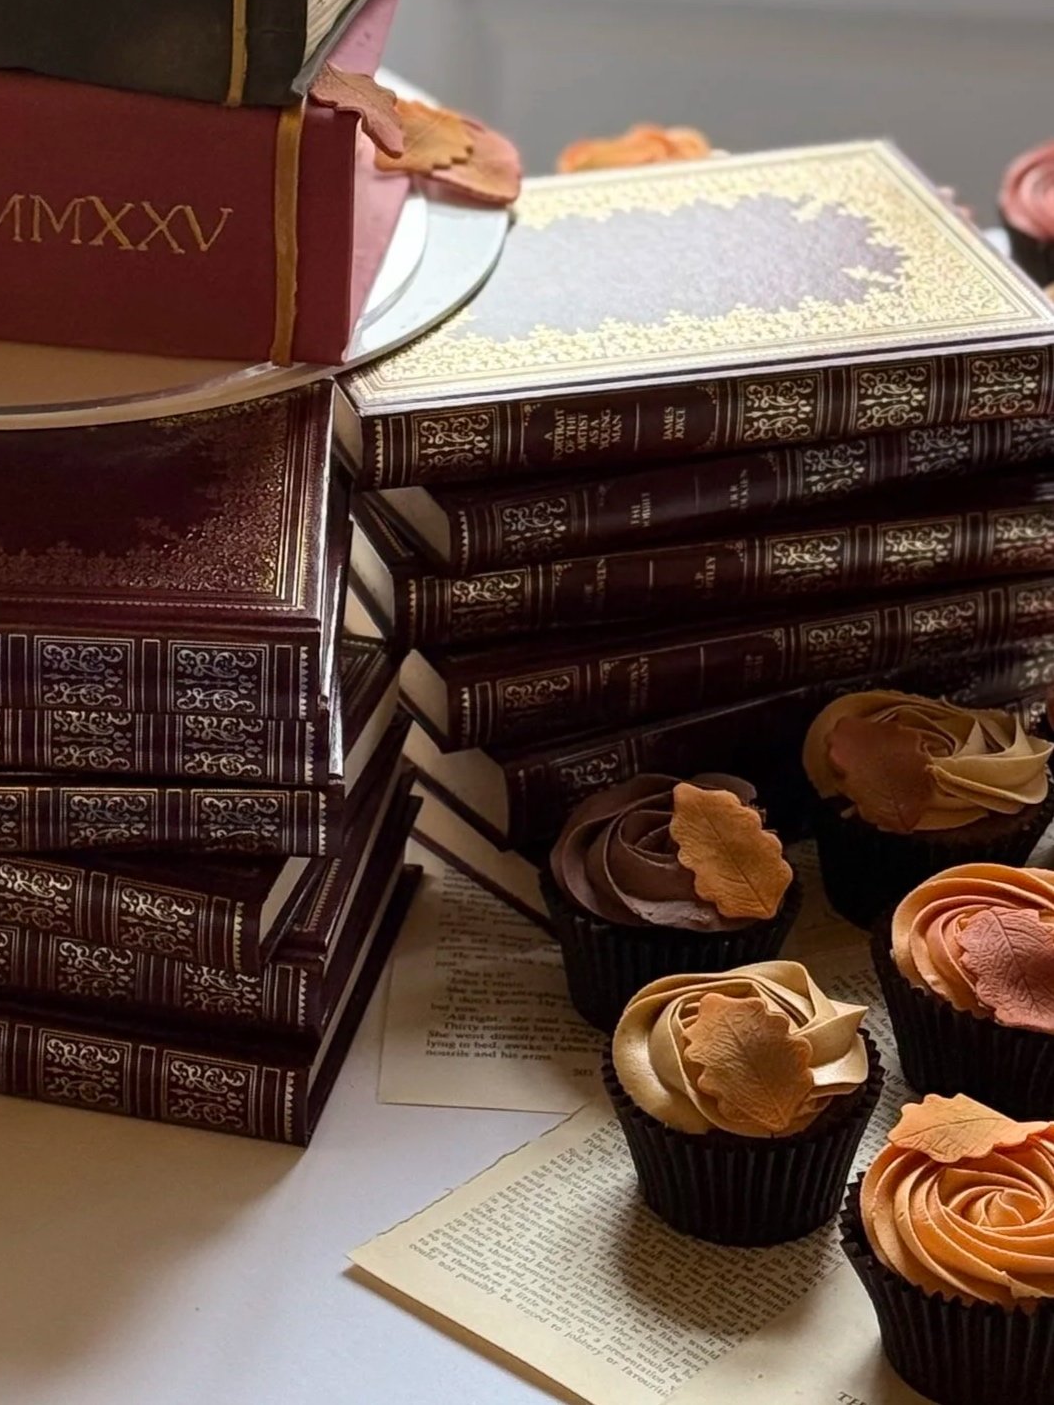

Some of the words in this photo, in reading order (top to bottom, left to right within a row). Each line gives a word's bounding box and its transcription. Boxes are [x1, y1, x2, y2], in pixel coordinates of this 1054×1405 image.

[408, 1243, 438, 1261] could
[437, 1260, 456, 1273] not
[454, 1272, 497, 1295] possibly
[499, 1292, 513, 1304] be
[515, 1302, 550, 1323] traced
[550, 1323, 563, 1332] to
[563, 1330, 604, 1356] jobbery
[605, 1356, 619, 1365] or
[417, 1236, 430, 1247] to
[428, 1246, 449, 1259] get
[450, 1257, 503, 1288] themselves
[514, 1291, 540, 1307] little
[576, 1326, 590, 1337] by
[601, 1343, 666, 1385] presentation
[426, 1232, 440, 1242] so
[440, 1241, 491, 1272] deservedly
[492, 1271, 507, 1280] an
[508, 1277, 554, 1306] infamous
[609, 1334, 633, 1351] they
[635, 1351, 669, 1374] would
[668, 1371, 683, 1383] be
[538, 1282, 563, 1301] have
[563, 1299, 579, 1309] no
[580, 1308, 611, 1326] doubt
[612, 1325, 635, 1341] they
[662, 1356, 681, 1370] for
